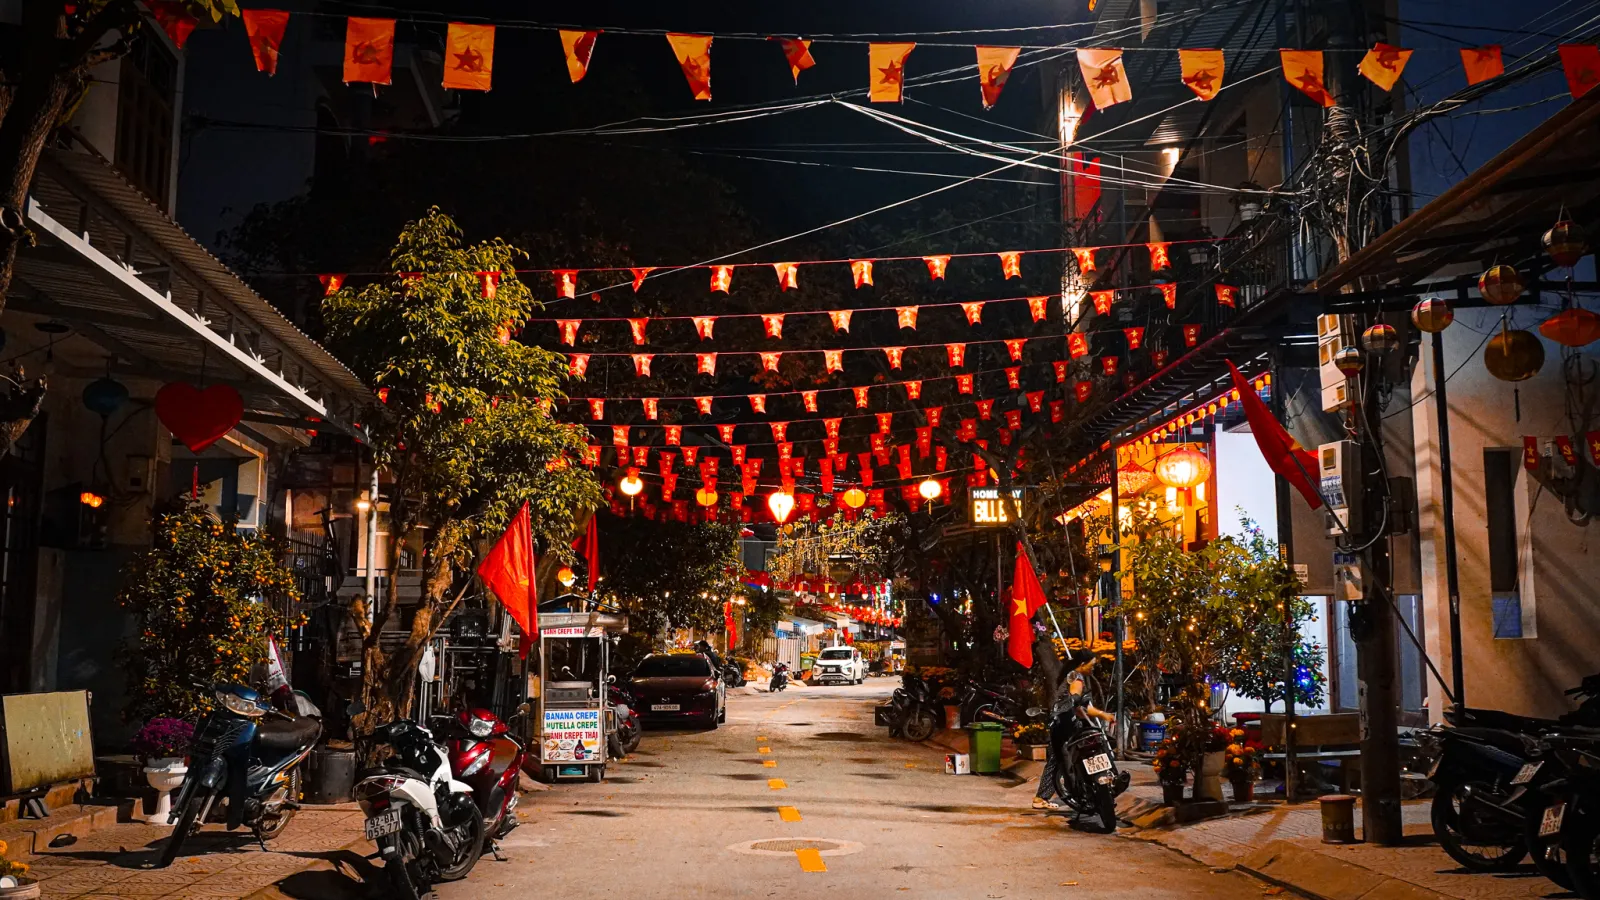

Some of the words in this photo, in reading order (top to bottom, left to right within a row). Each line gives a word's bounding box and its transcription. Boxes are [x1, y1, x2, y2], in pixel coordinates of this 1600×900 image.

[973, 490, 1021, 499] HOMEY
[545, 712, 574, 720] BANANA
[575, 711, 598, 720] CREPE
[576, 721, 598, 729] CREPE
[564, 732, 583, 740] CREPE
[370, 812, 395, 829] 92-BA
[368, 820, 399, 839] 055.77
